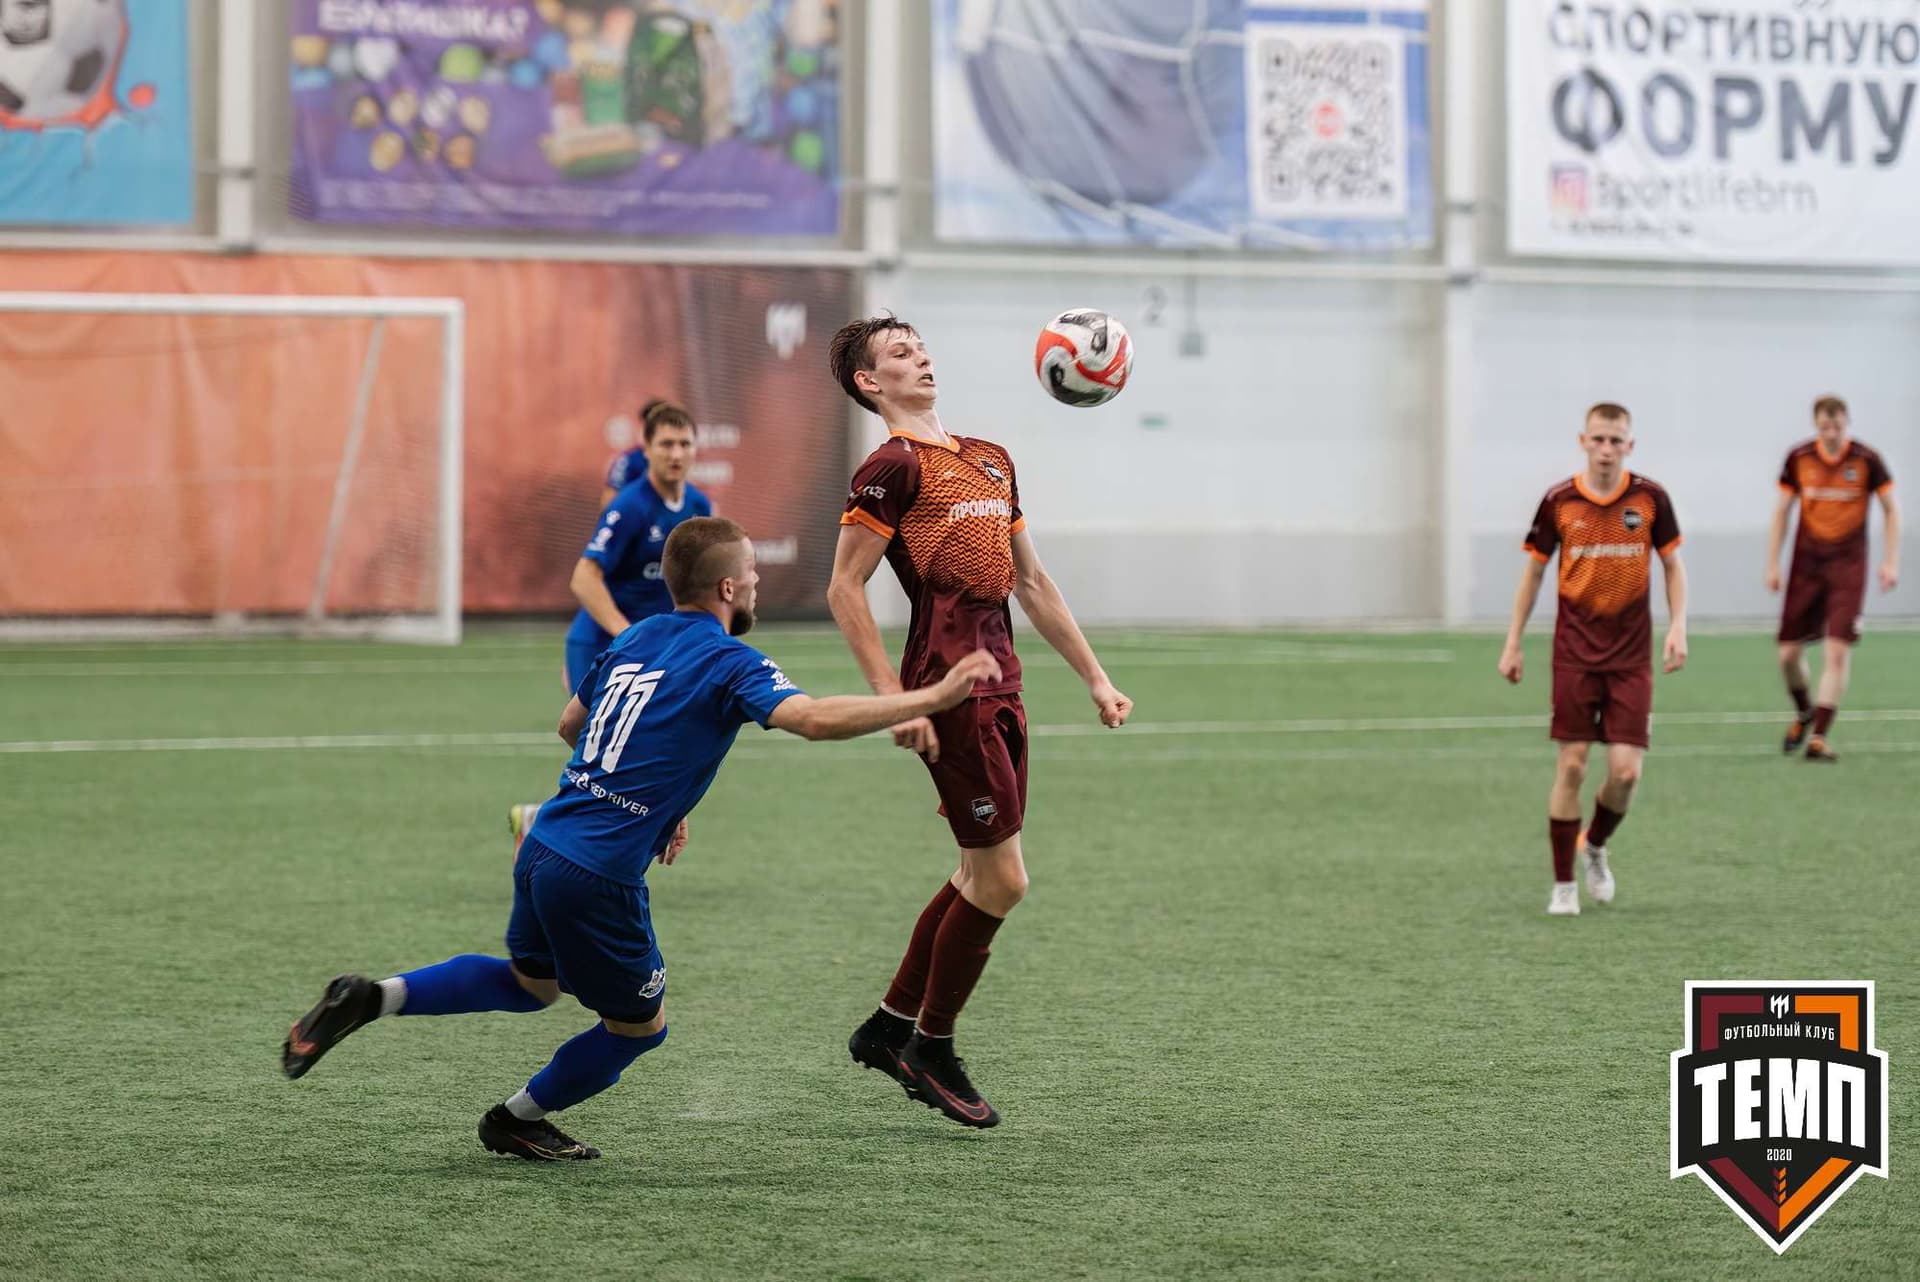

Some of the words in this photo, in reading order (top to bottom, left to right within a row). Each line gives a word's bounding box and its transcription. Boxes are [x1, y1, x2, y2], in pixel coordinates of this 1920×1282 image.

[1551, 3, 1919, 63] СПОРТИВНУЮ
[1552, 68, 1916, 164] ФОРМУ
[607, 791, 649, 817] RIVER
